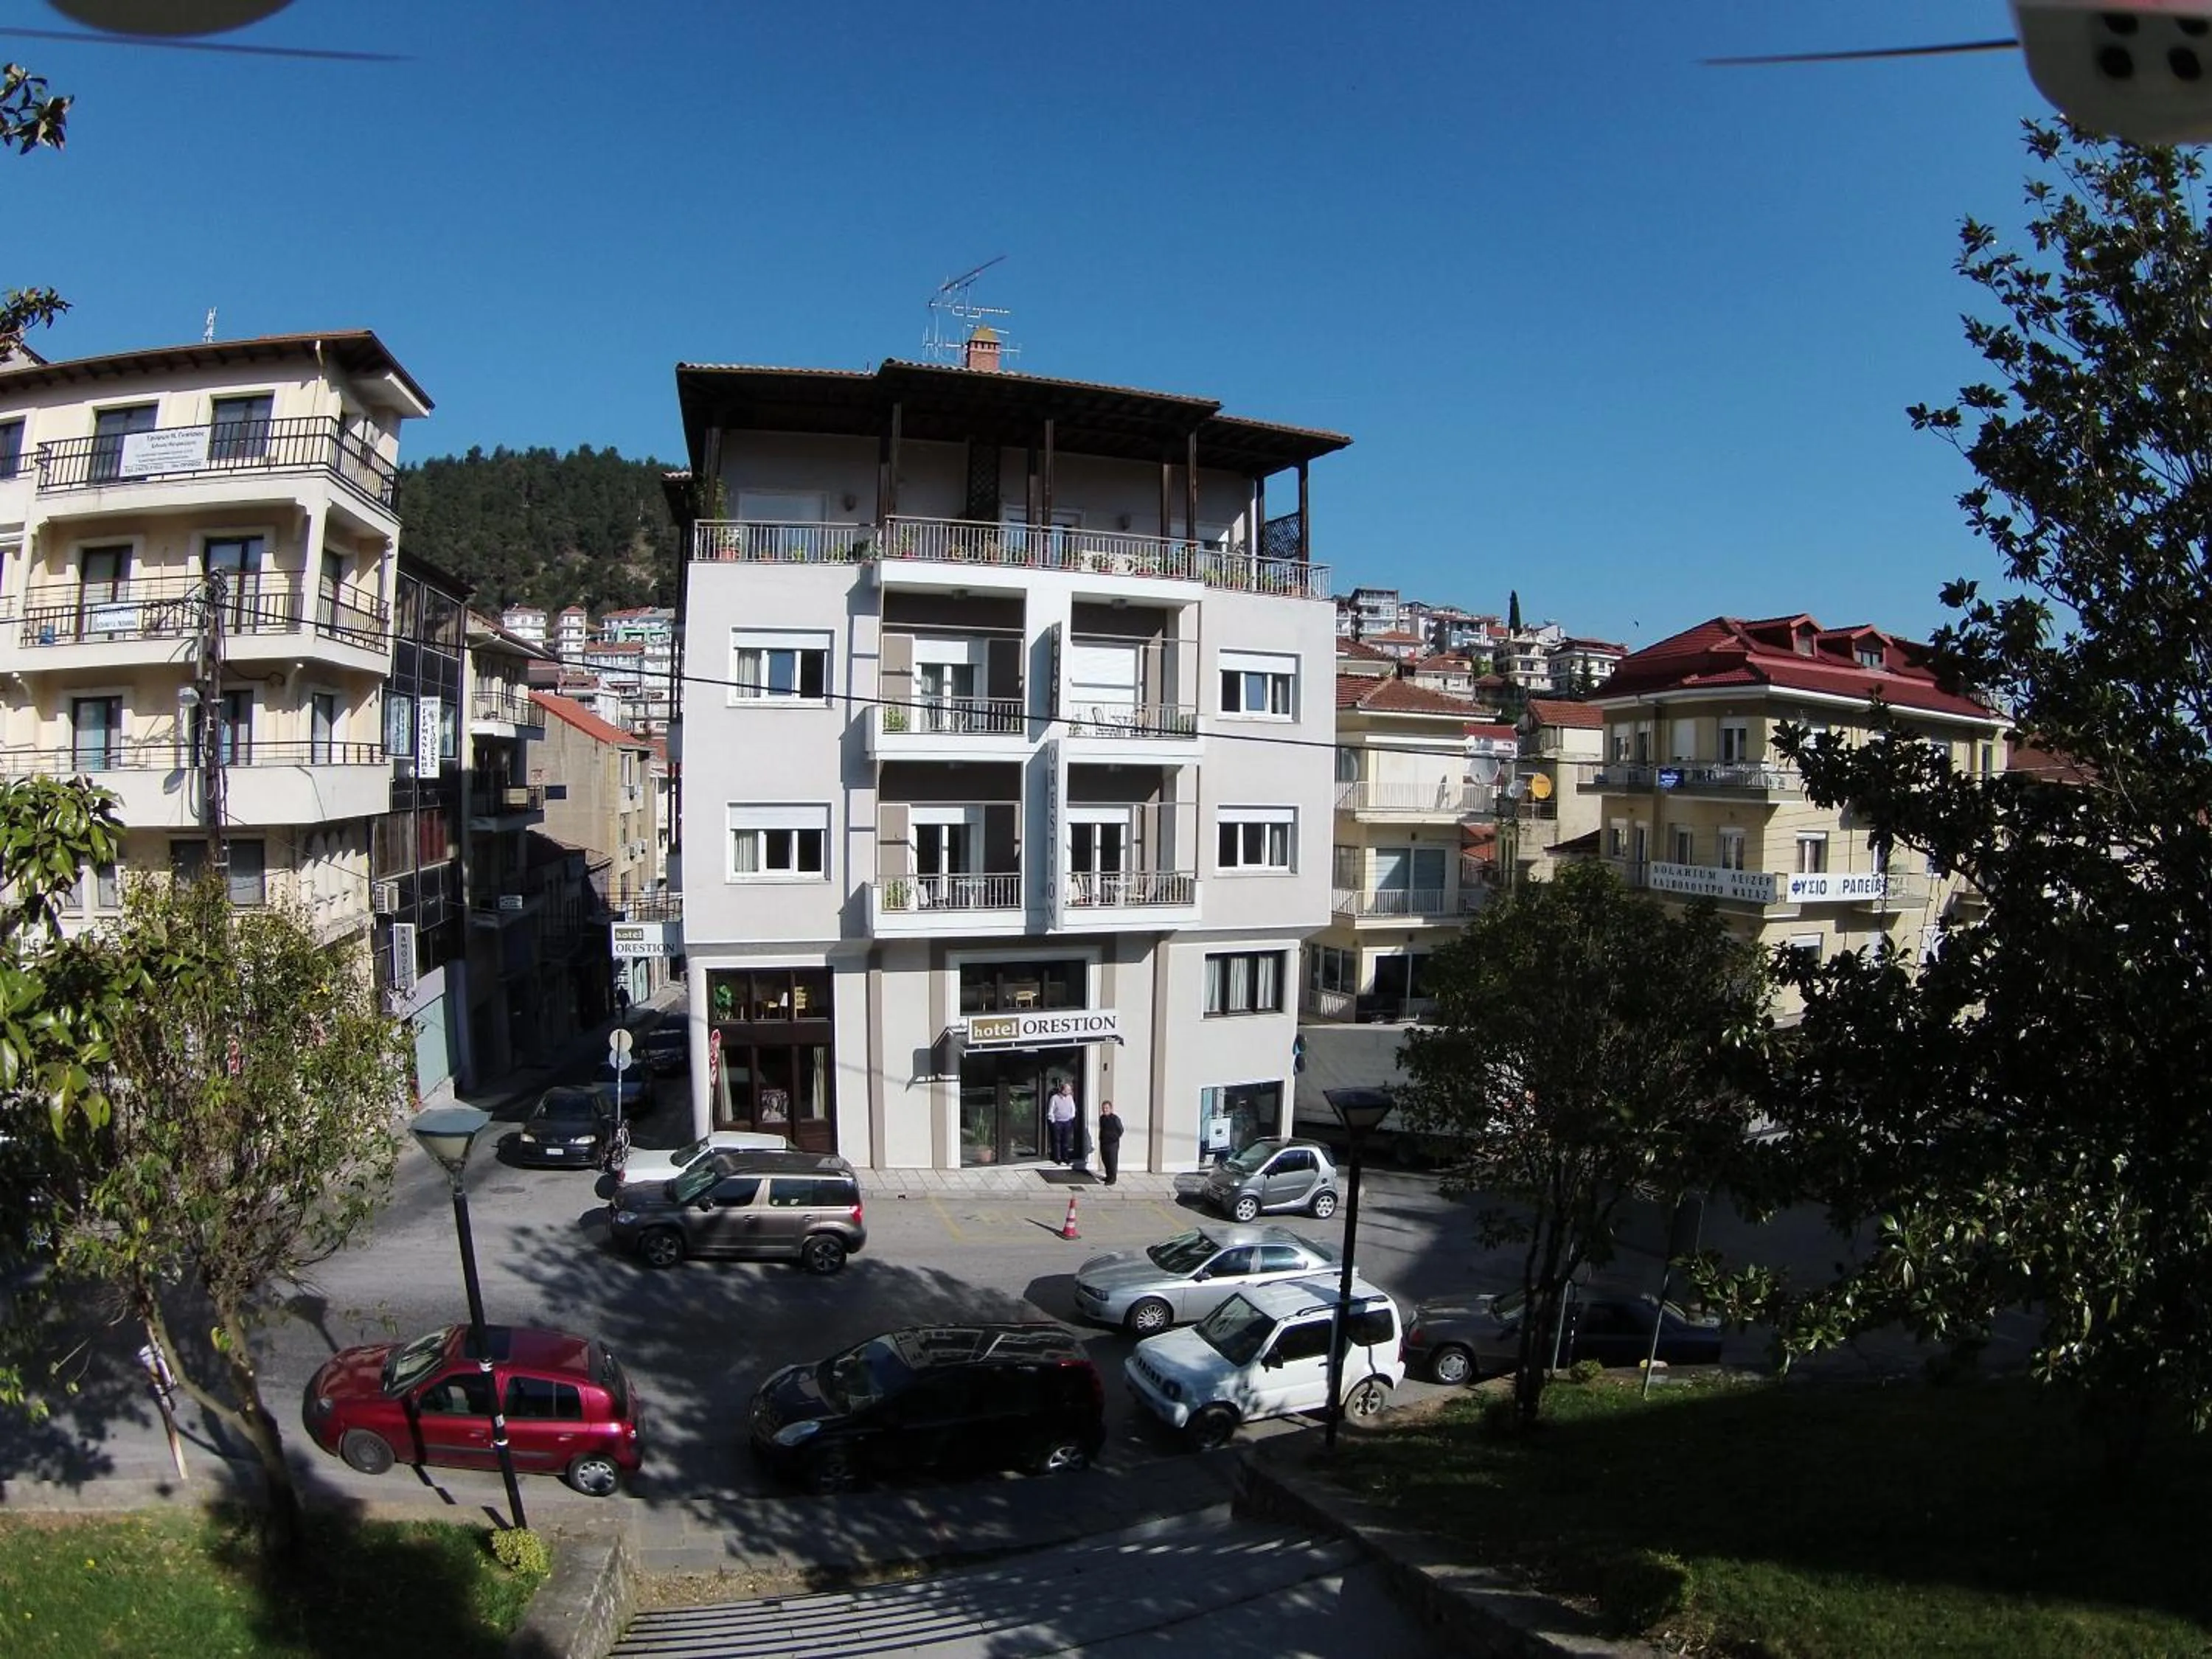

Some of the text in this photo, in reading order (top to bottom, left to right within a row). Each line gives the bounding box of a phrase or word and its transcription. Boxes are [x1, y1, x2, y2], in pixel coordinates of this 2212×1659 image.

[1048, 748, 1057, 921] ORESTION
[1654, 864, 1716, 880] SOLARIUM
[616, 931, 642, 939] hotel
[616, 944, 675, 953] ORESTION
[974, 1015, 1116, 1037] hotel ORESTION
